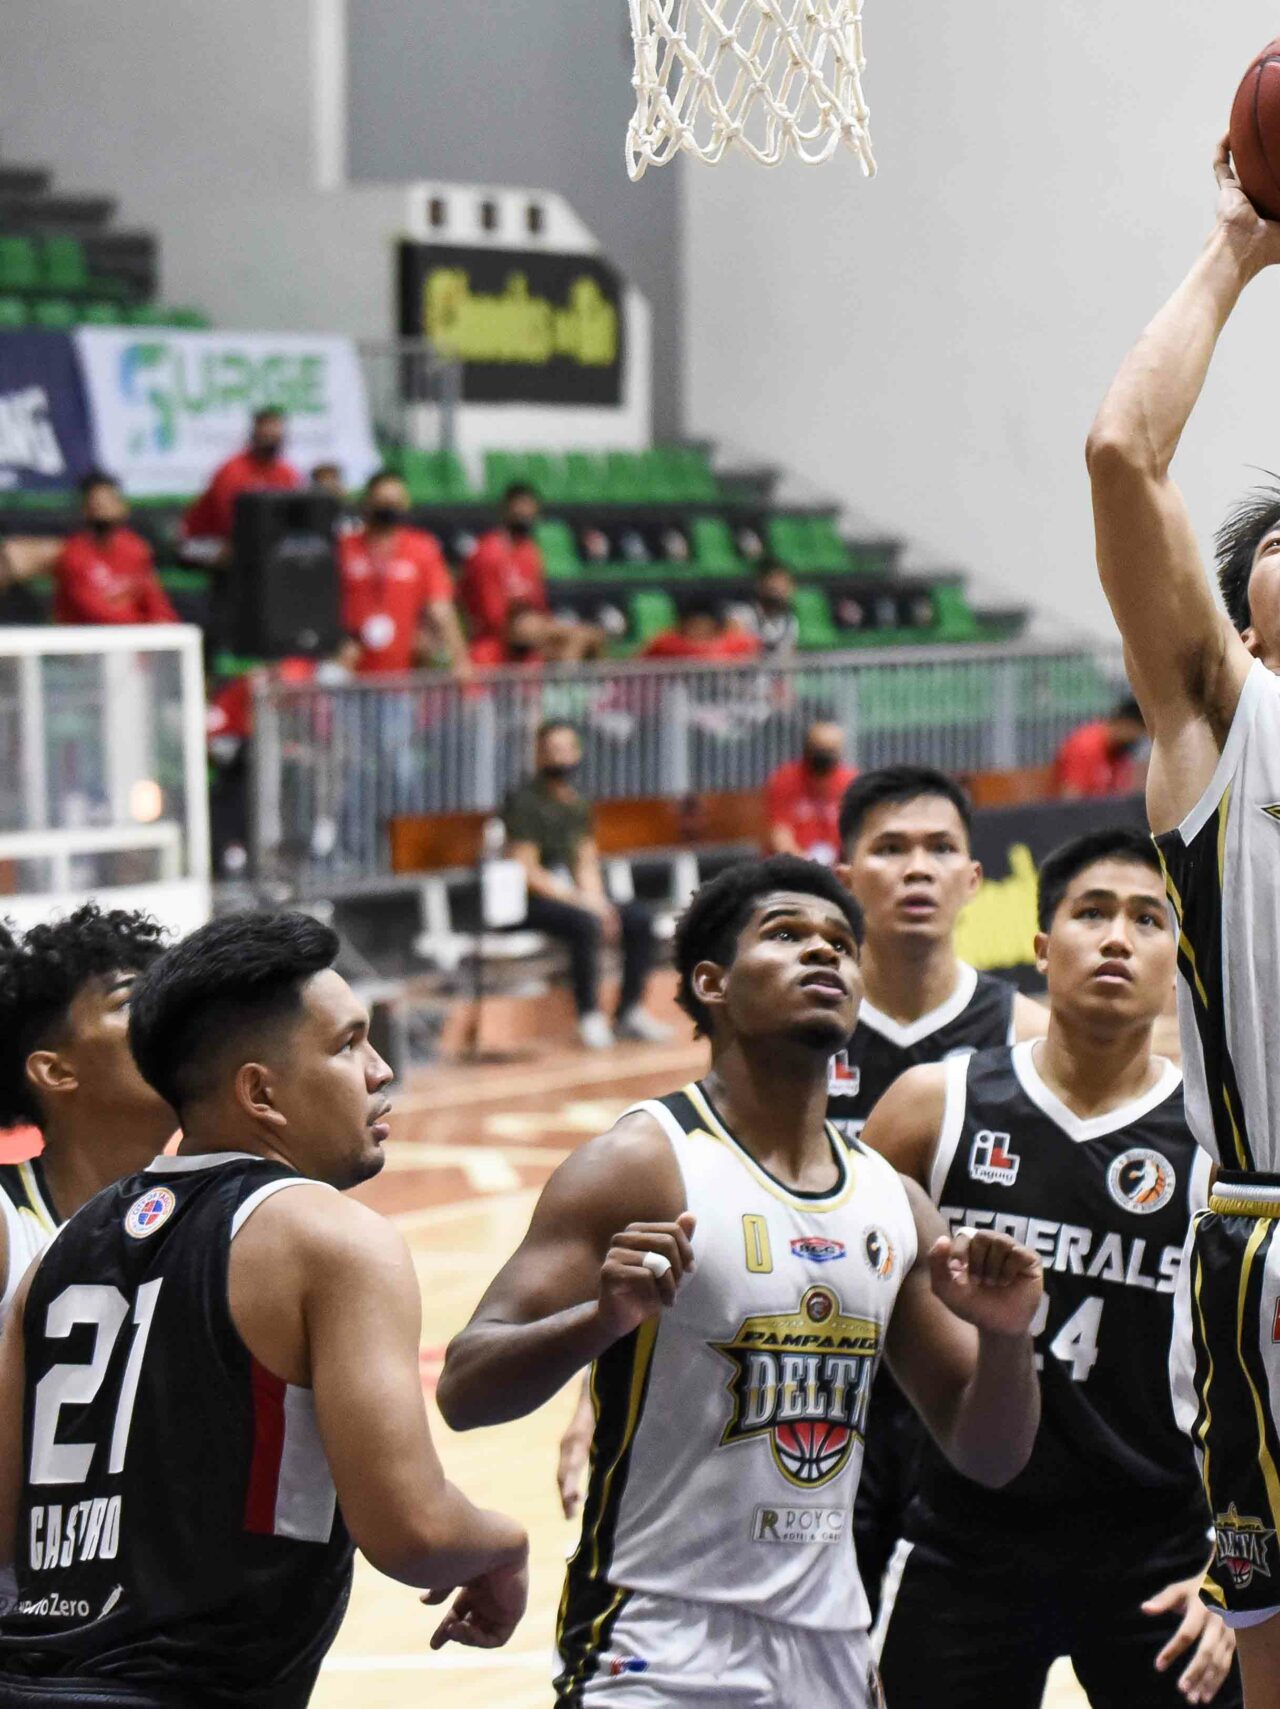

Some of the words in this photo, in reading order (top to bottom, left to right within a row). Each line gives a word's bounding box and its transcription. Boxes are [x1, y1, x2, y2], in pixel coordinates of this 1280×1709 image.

[1028, 1292, 1105, 1382] 4
[28, 1276, 164, 1486] 21
[741, 1352, 873, 1434] DELTA
[30, 1494, 122, 1571] CASTRO
